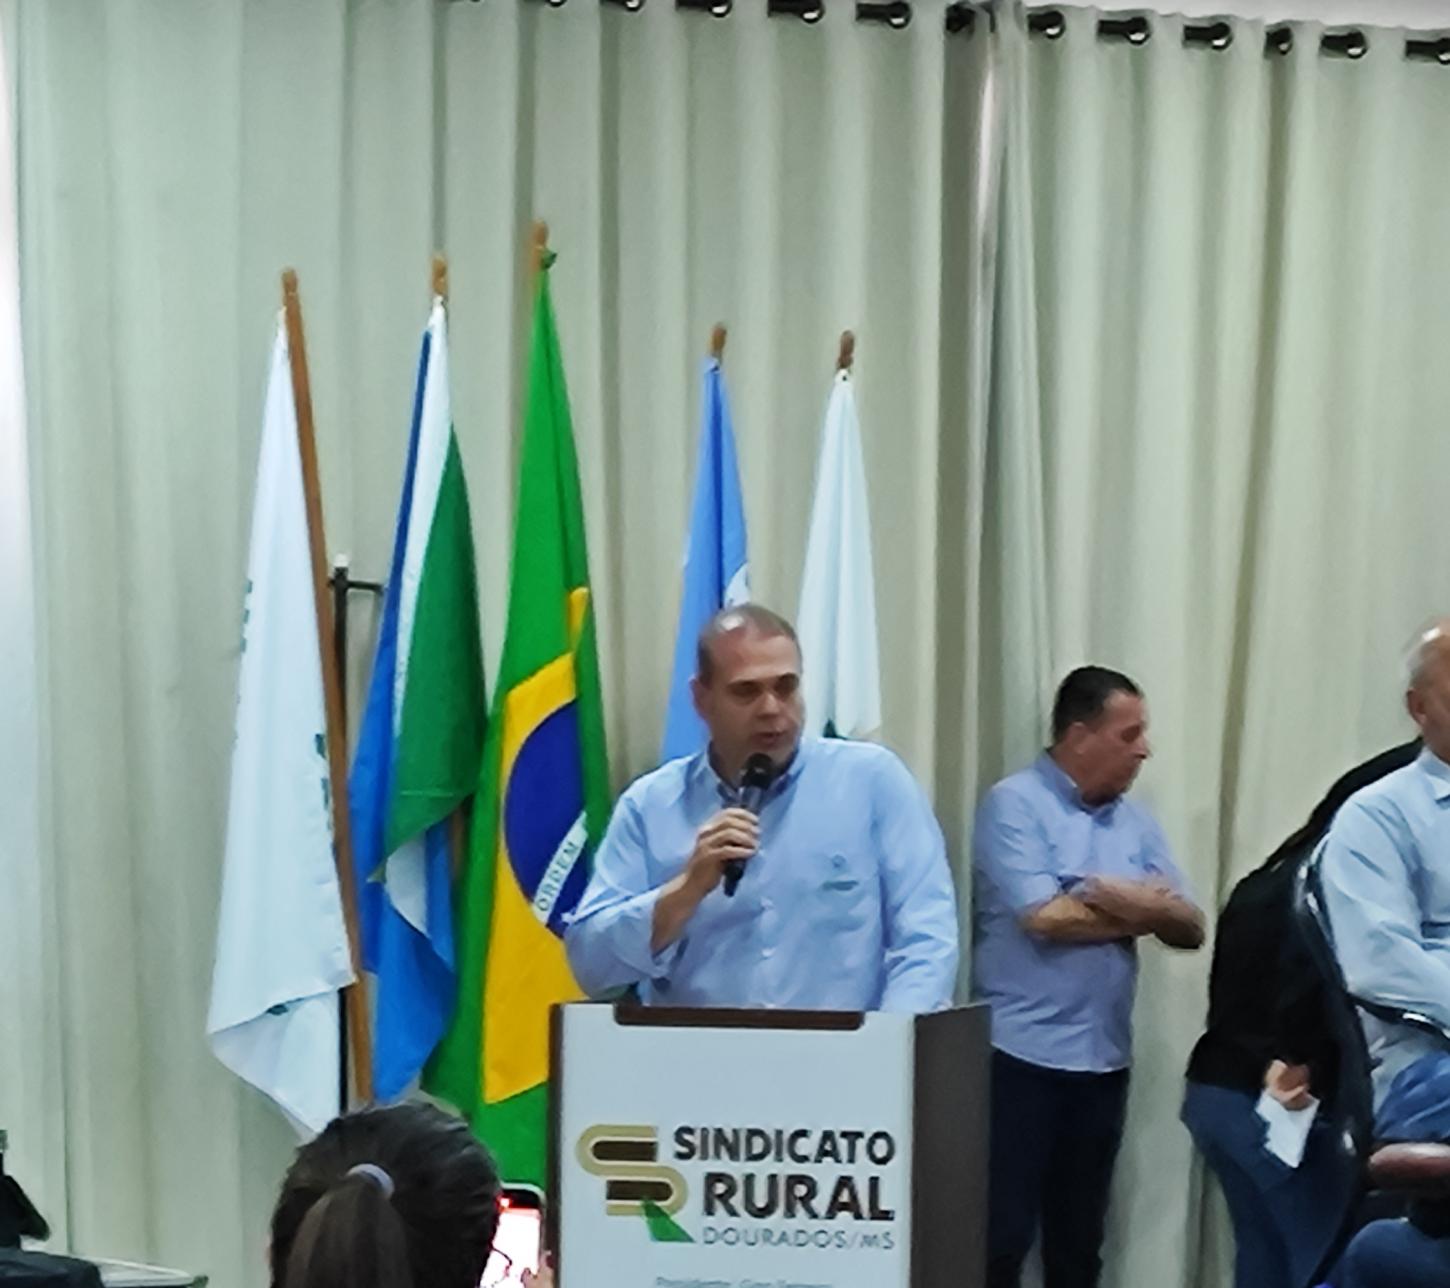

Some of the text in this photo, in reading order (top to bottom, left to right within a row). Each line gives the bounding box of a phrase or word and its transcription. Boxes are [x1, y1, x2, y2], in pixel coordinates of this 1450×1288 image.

[674, 1126, 896, 1165] SINDICATO
[703, 1172, 895, 1221] RURAL
[703, 1226, 895, 1250] DOURADOS/MS
